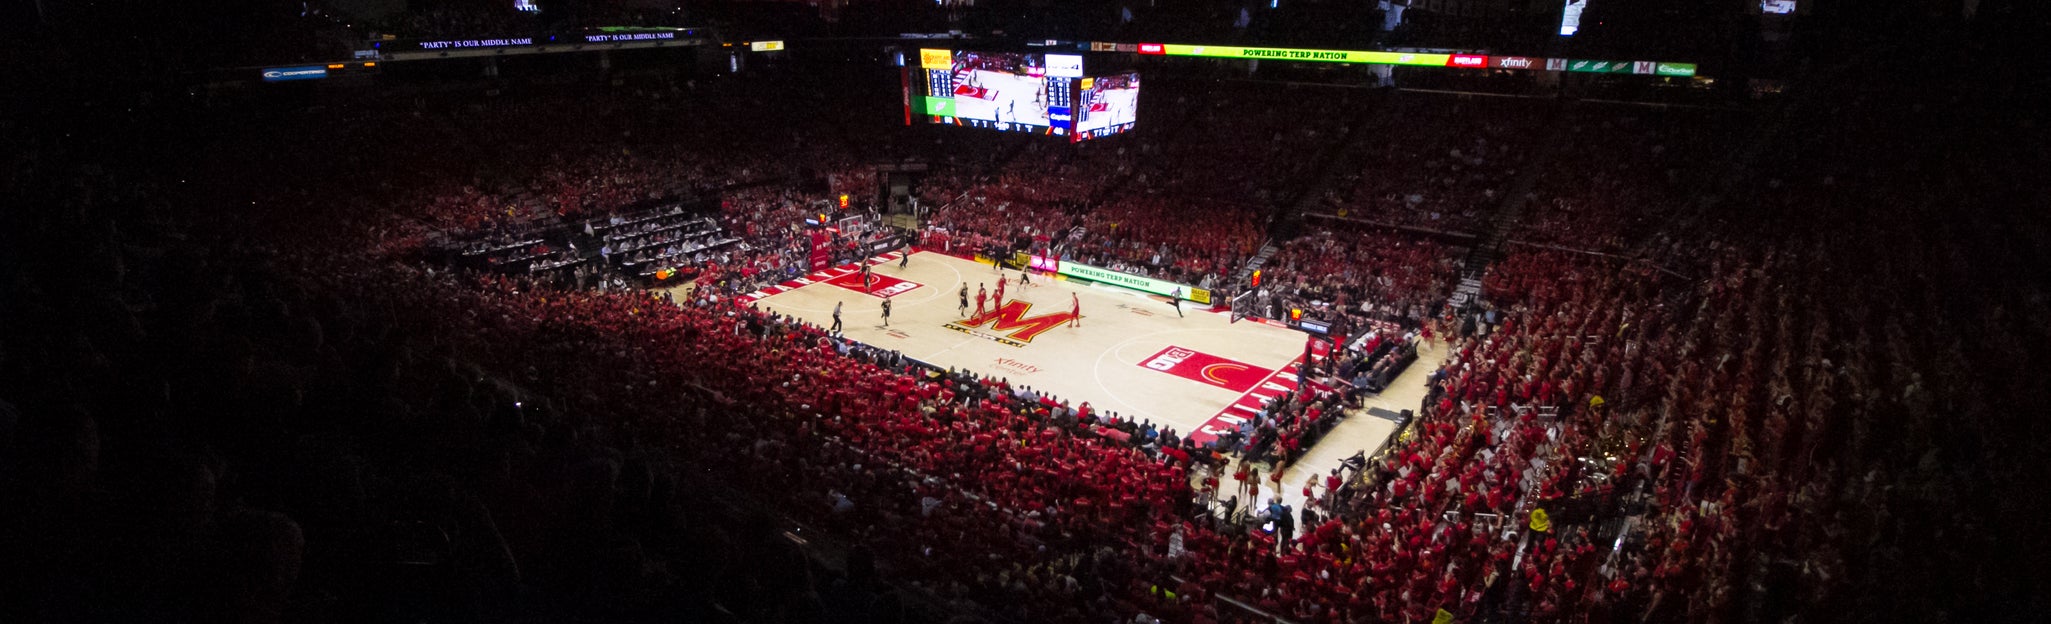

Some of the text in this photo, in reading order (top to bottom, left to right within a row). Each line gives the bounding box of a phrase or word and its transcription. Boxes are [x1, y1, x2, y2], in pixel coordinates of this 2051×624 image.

[420, 40, 452, 49] "PARTY"
[454, 40, 462, 48] IS
[481, 39, 510, 47] MIDDLE
[1243, 49, 1287, 57] POWERING
[1313, 51, 1348, 60] NATION
[1500, 57, 1533, 69] xfinity
[1071, 266, 1150, 287] POWERING TERP NATION
[994, 357, 1044, 373] xfinity
